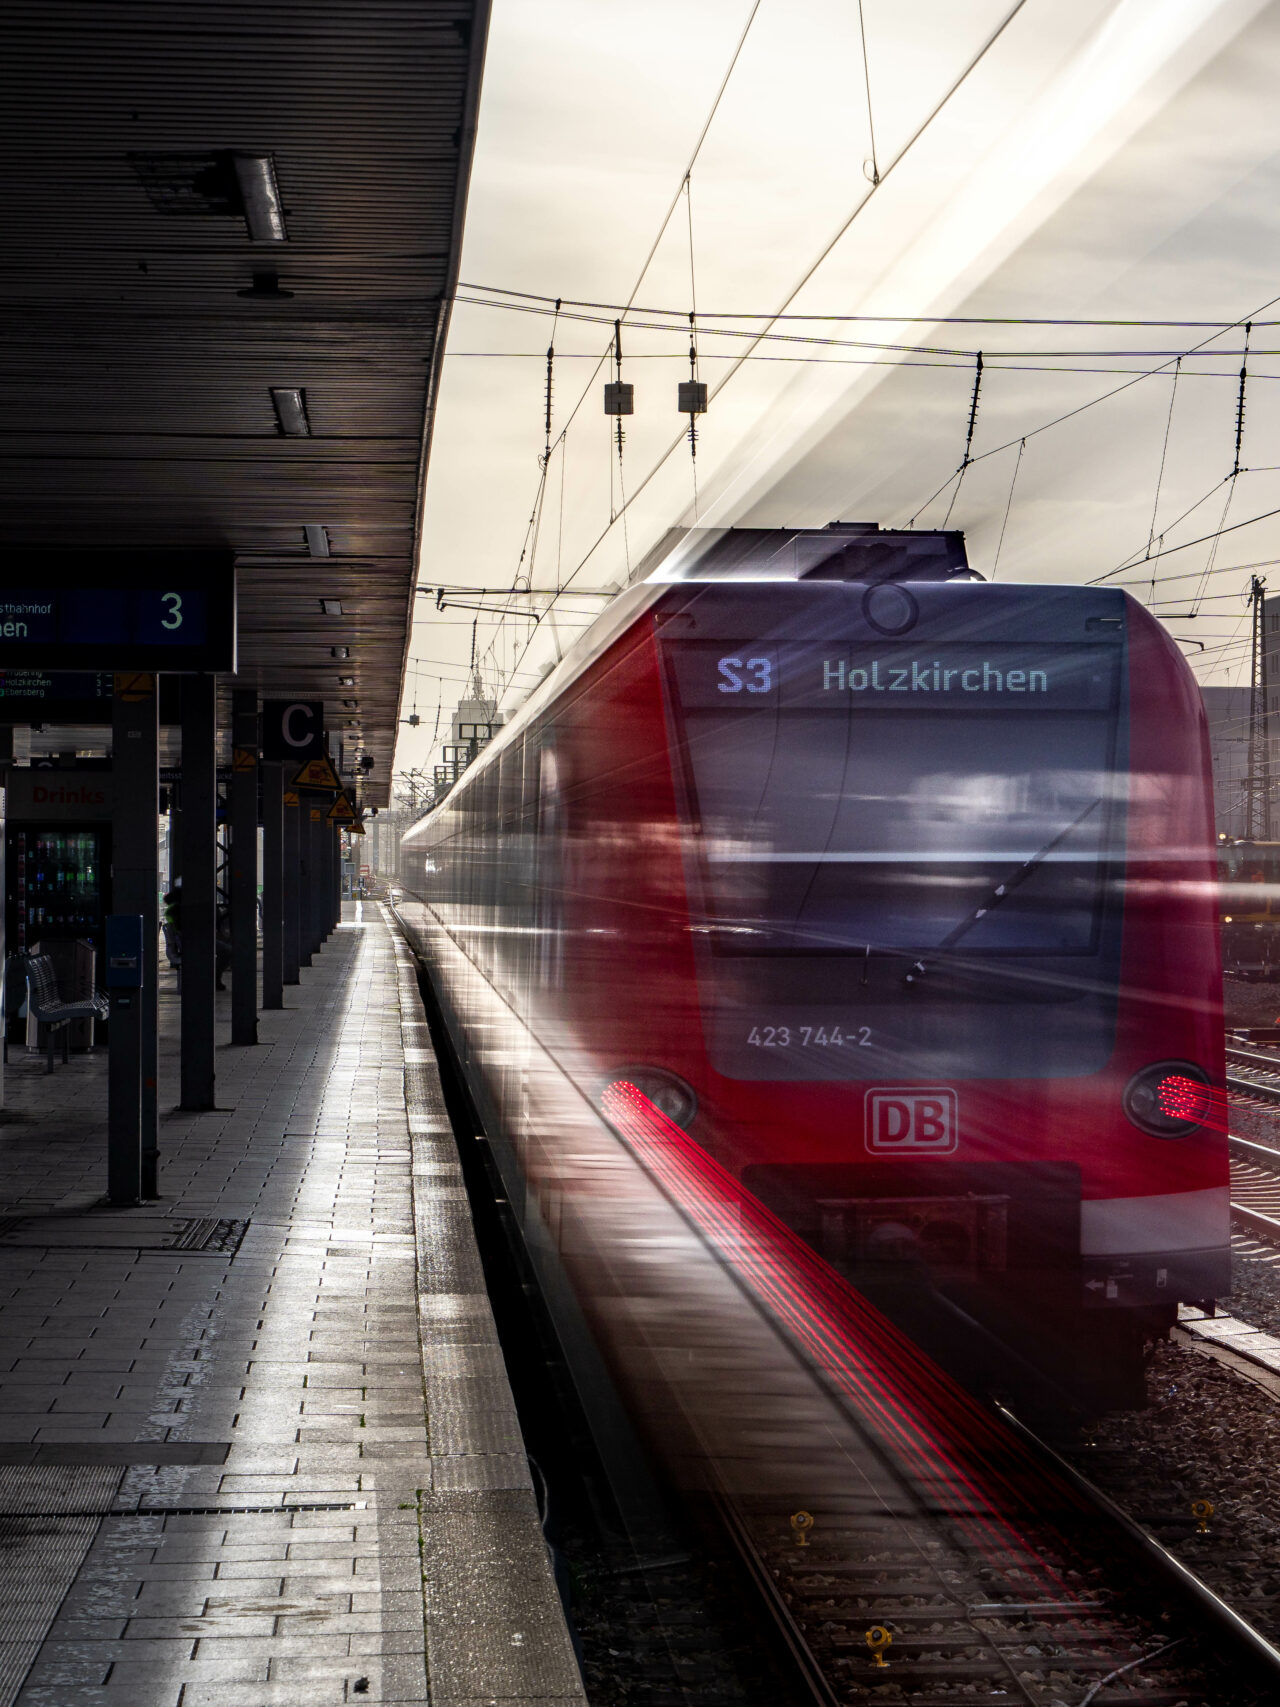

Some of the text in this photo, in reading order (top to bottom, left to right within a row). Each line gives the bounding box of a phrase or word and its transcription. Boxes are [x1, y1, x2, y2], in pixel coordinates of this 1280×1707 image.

[160, 592, 183, 630] 3
[716, 657, 1048, 693] S3 Holzkirchen
[281, 703, 314, 748] C
[33, 786, 105, 804] Drinks
[747, 1026, 872, 1047] 423 744-2
[876, 1098, 947, 1144] DB
